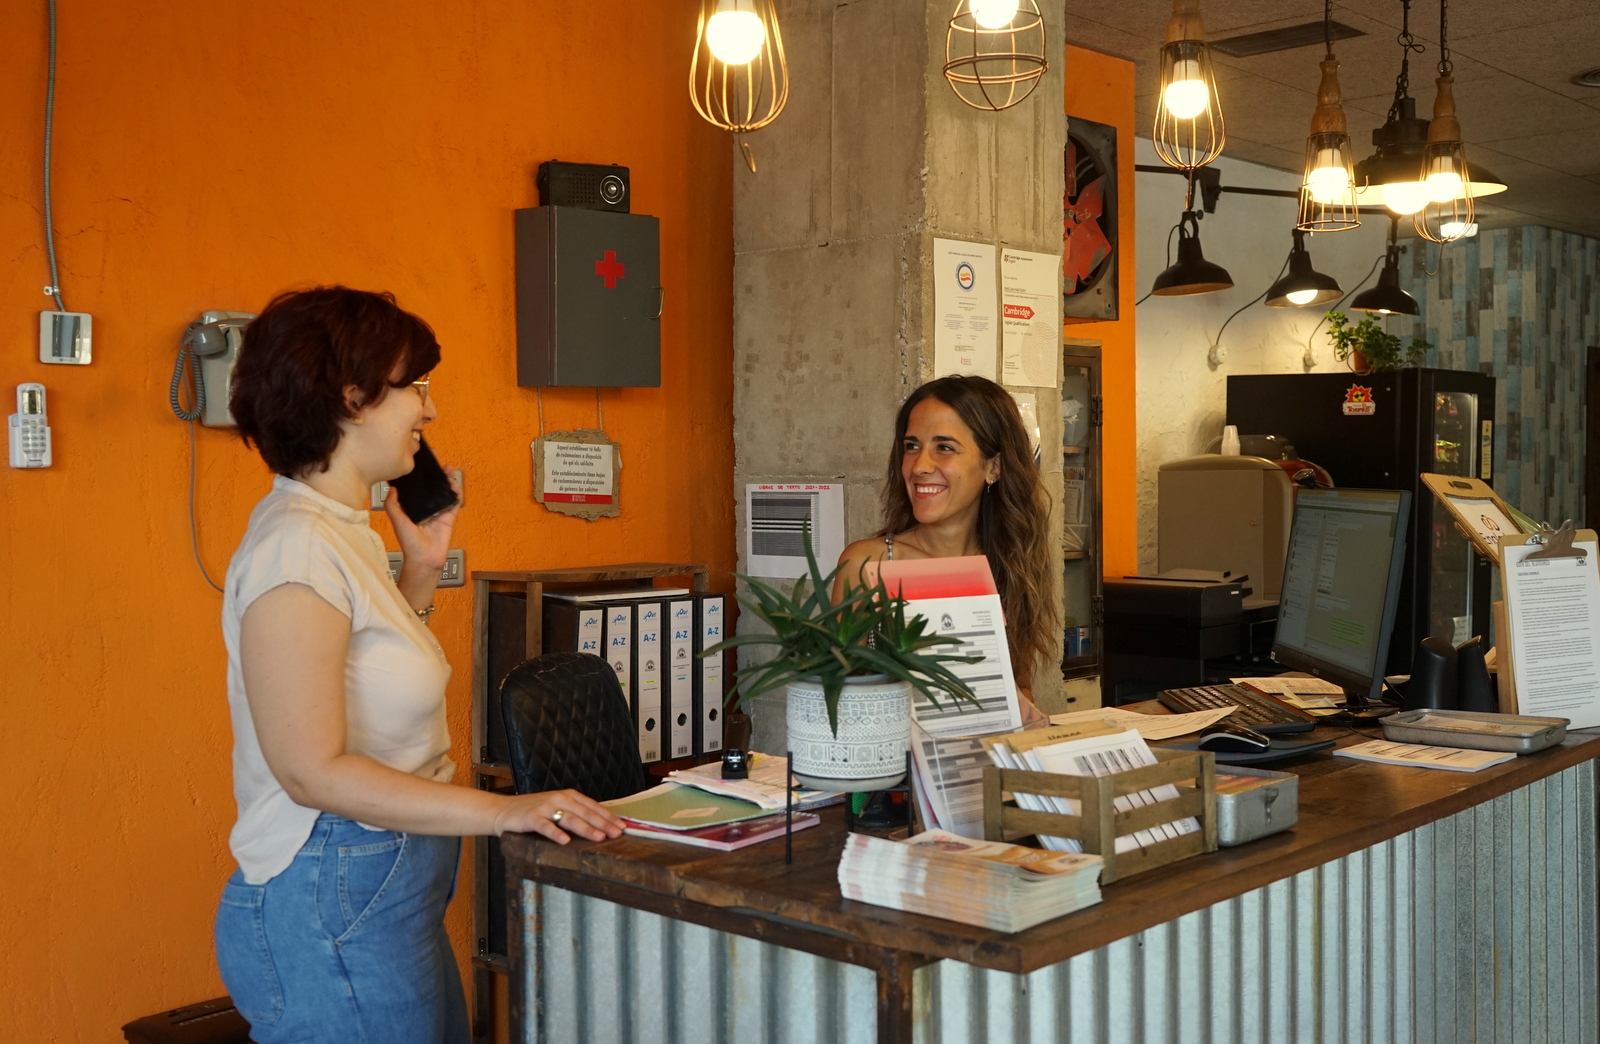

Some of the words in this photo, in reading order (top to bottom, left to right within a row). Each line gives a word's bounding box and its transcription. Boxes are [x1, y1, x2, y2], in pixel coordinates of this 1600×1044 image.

[1004, 306, 1030, 318] Cambridge
[675, 630, 688, 639] A-Z
[707, 627, 719, 635] A-Z
[612, 638, 626, 646] A-Z
[643, 634, 656, 642] A-Z
[583, 641, 596, 650] A-Z
